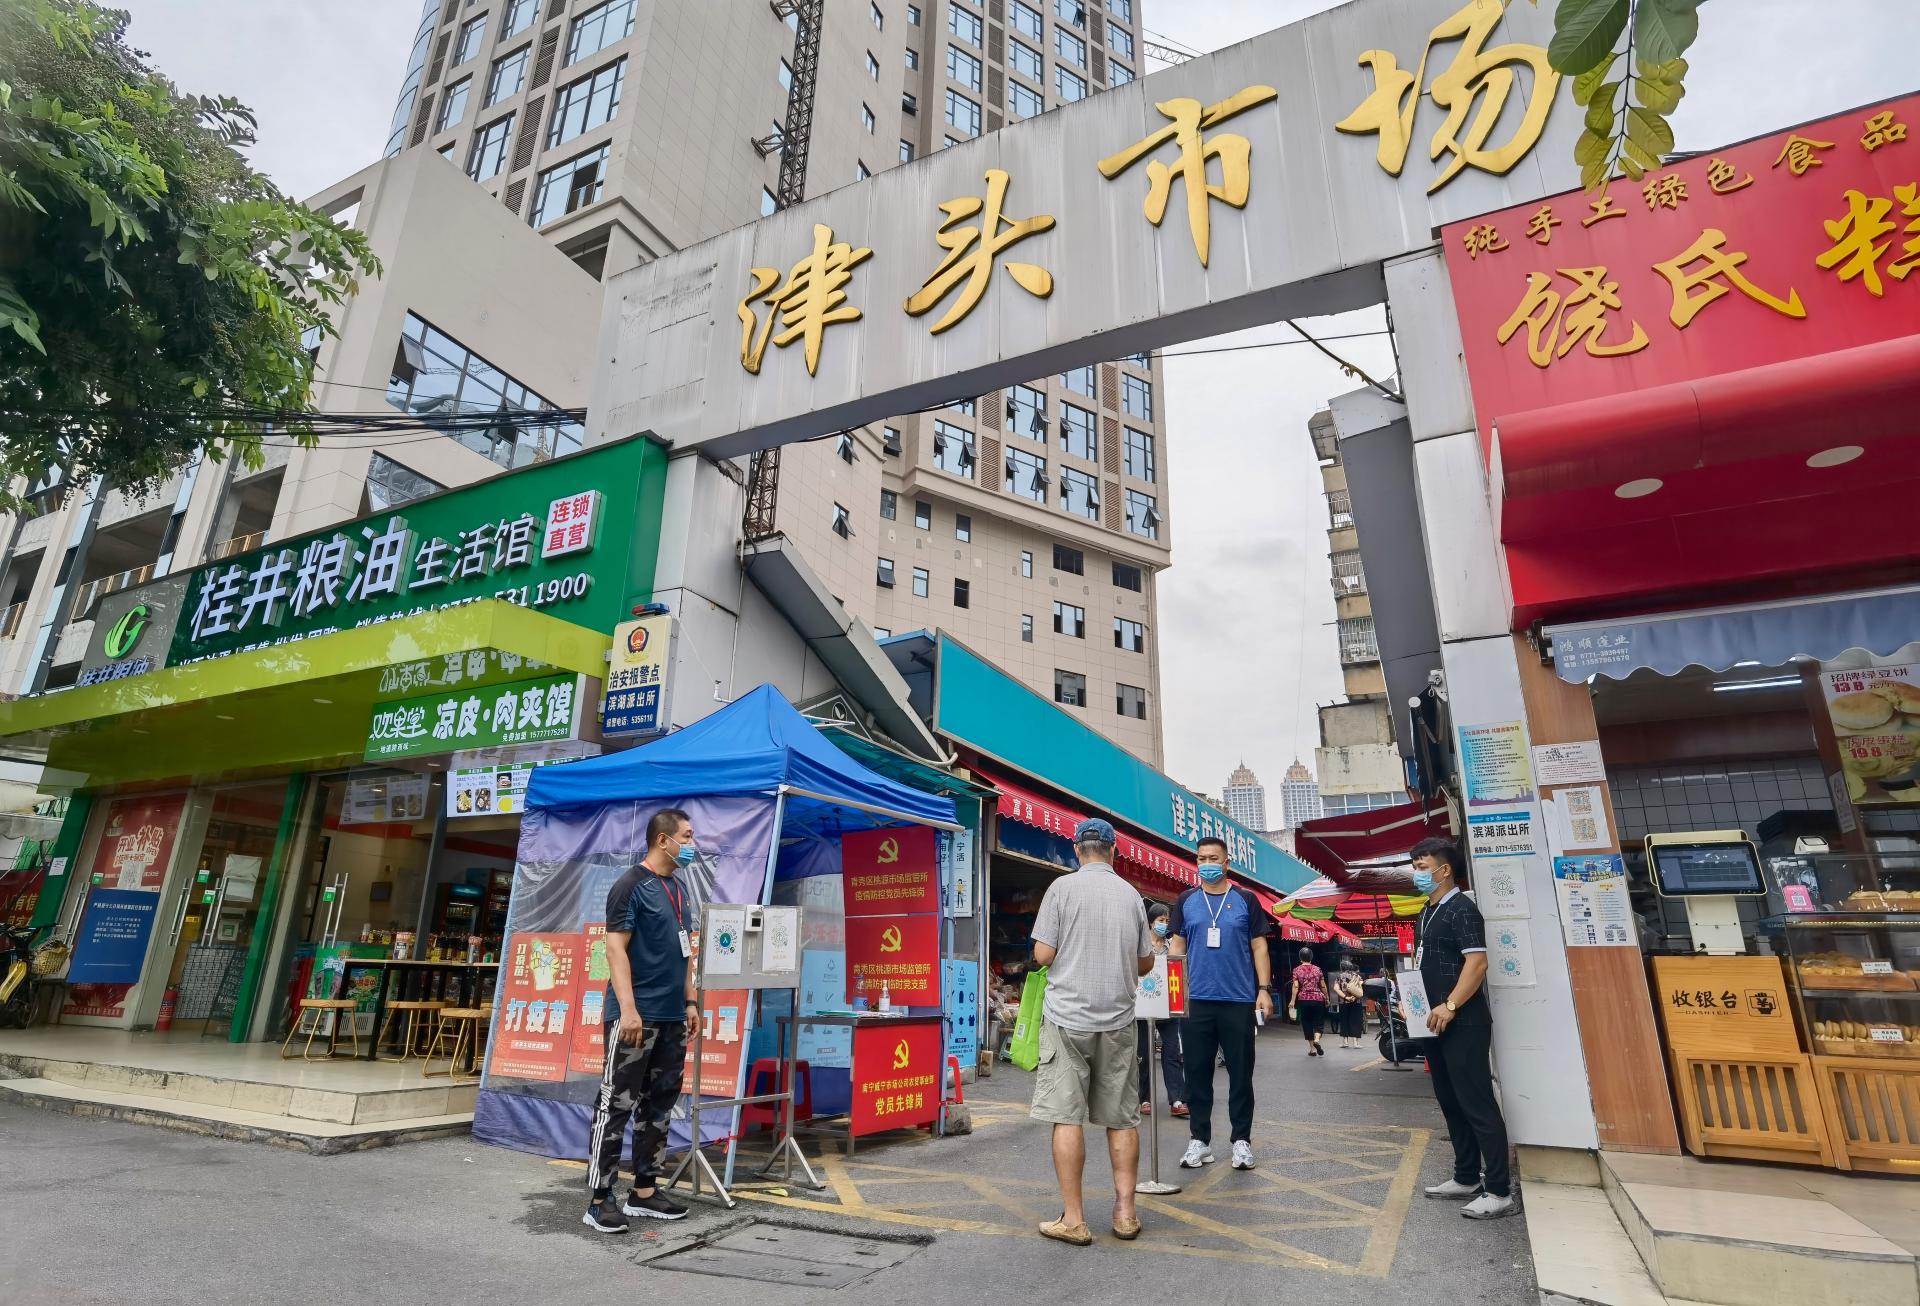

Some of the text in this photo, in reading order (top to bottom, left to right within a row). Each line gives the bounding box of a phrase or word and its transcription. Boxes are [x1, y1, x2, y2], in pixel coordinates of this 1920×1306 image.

[737, 0, 1564, 376] 津头市场
[1463, 111, 1908, 260] 纯手工绿色食品
[551, 494, 591, 525] 连锁
[546, 521, 587, 551] 直营
[533, 573, 588, 604] 1900
[609, 664, 660, 689] 治安报警点
[607, 690, 656, 710] 滨湖派出所
[502, 731, 527, 742] 免费加盟
[1013, 798, 1034, 821] 富强
[1044, 810, 1061, 831] 民主
[1472, 823, 1529, 839] 滨湖派出所
[1672, 989, 1737, 1009] 收银台
[504, 997, 570, 1035] 打疫苗
[875, 1091, 923, 1116] 党员先锋岗
